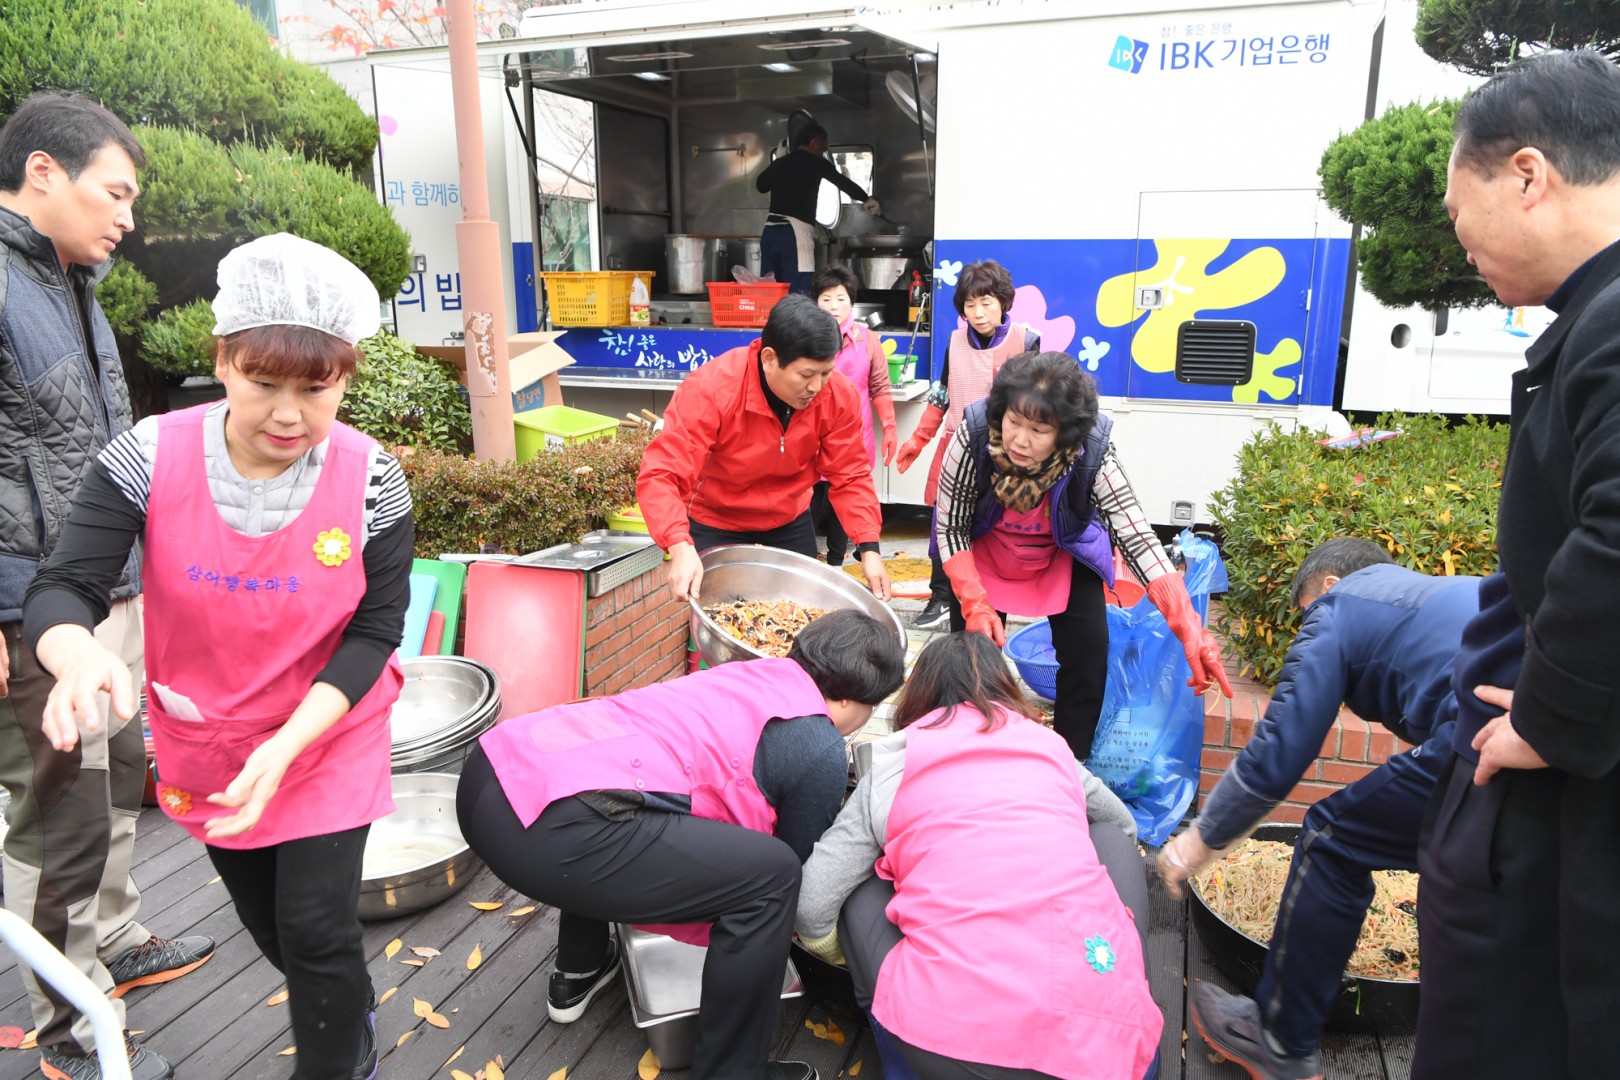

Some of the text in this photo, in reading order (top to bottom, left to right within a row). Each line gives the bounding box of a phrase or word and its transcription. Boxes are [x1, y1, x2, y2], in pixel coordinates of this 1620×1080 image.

[1161, 22, 1233, 38] 참! 좋은 은행
[386, 180, 406, 206] 과
[637, 334, 657, 351] 좋은
[635, 350, 676, 370] 사랑의
